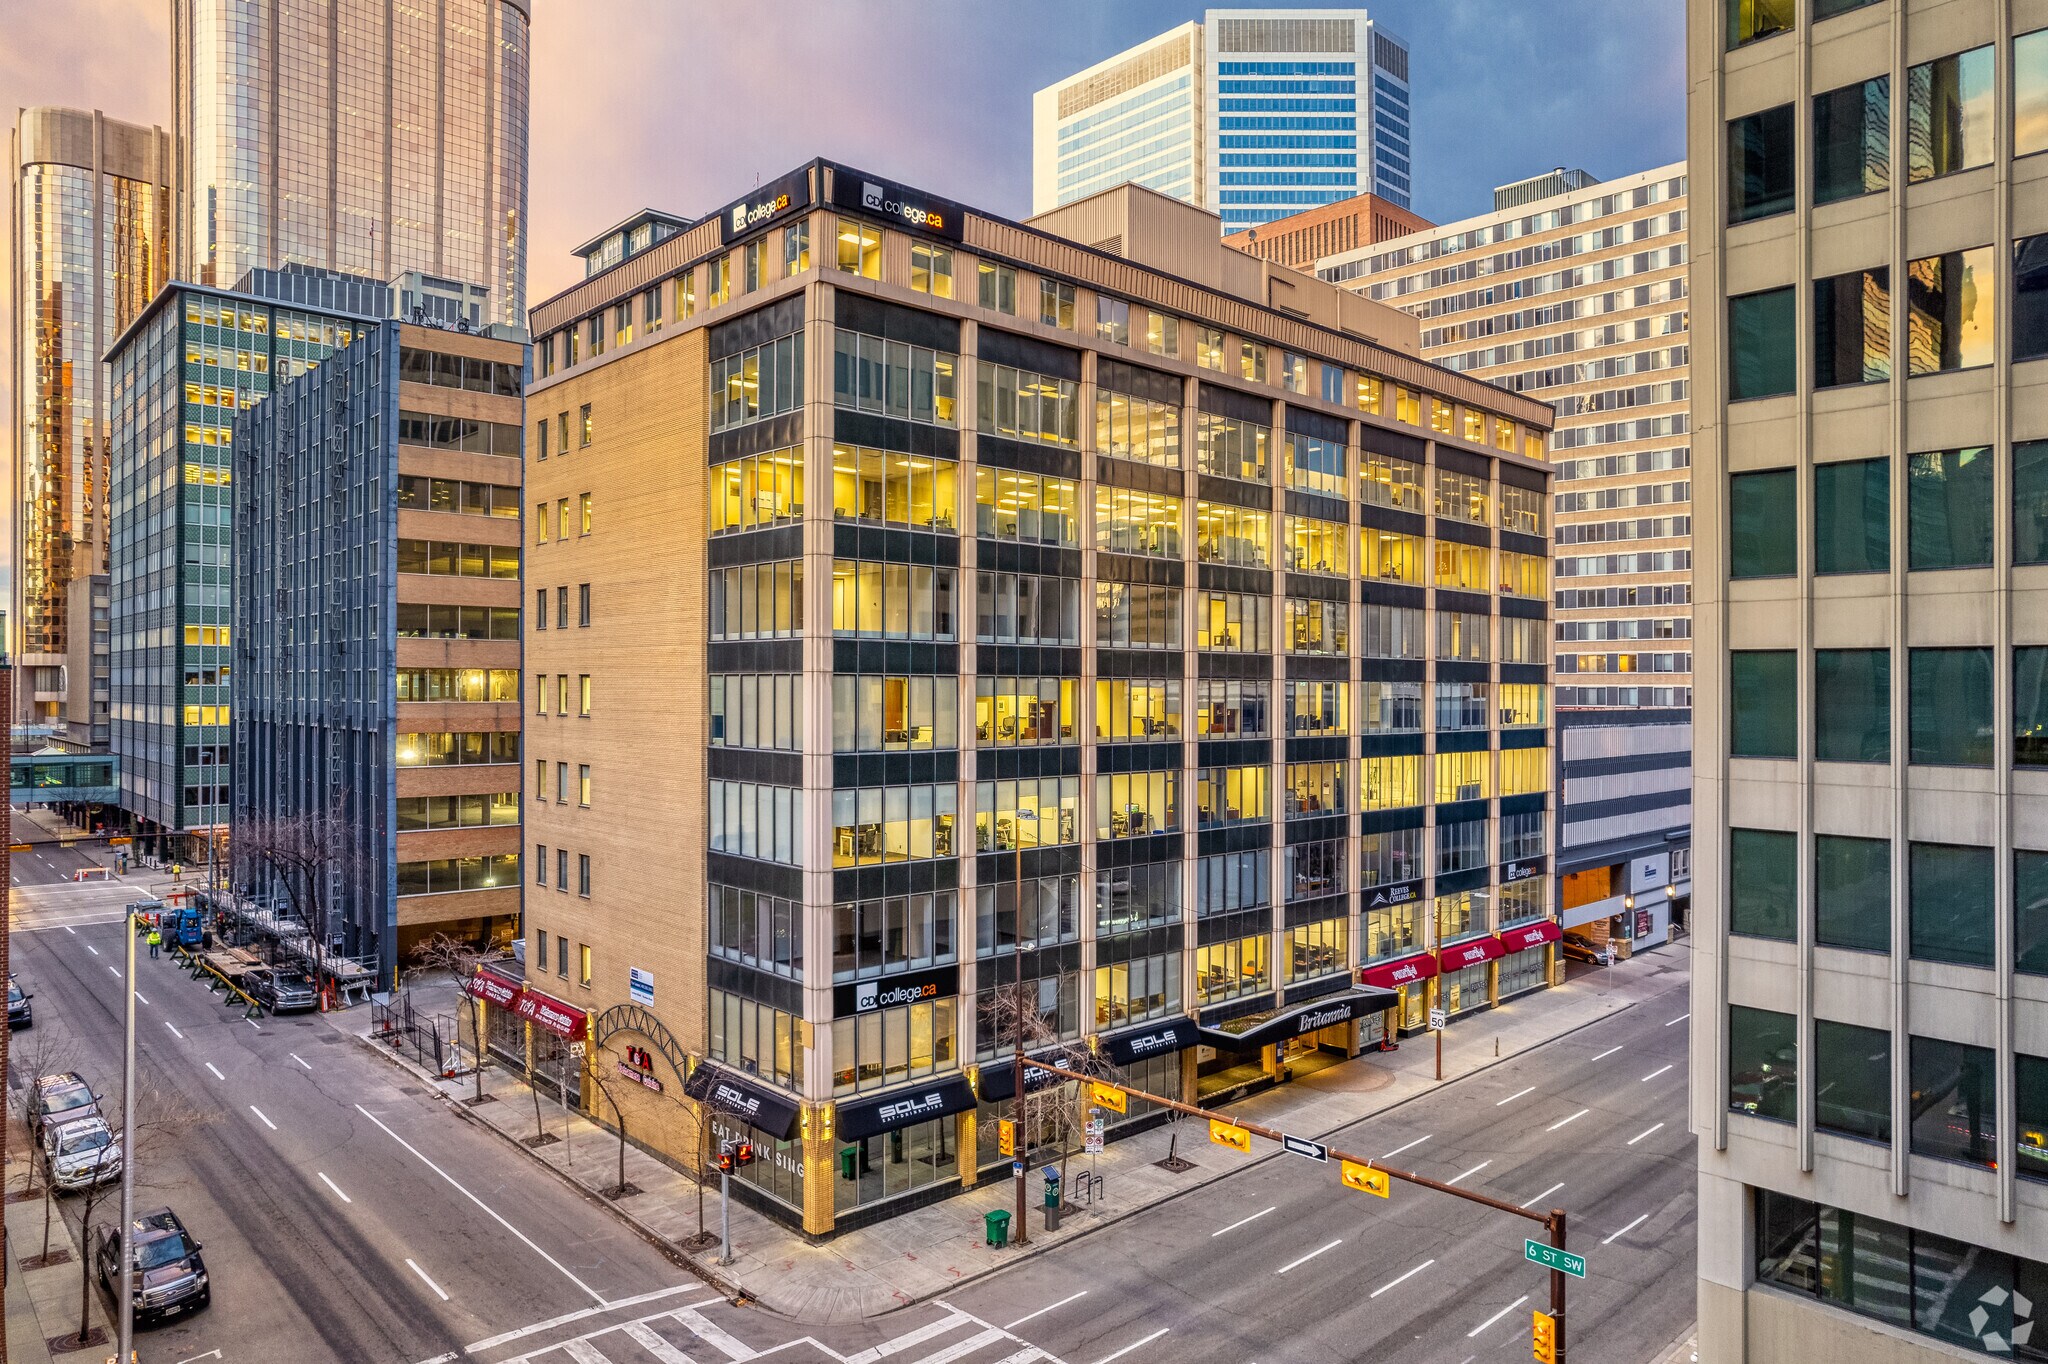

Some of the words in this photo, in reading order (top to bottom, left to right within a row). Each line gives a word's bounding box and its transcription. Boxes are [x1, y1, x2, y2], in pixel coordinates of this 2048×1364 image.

[747, 193, 789, 224] college.ca
[885, 200, 943, 229] college.ca
[880, 983, 937, 1004] college.ca
[1299, 1003, 1352, 1032] Britannia
[1431, 1017, 1444, 1028] 50
[1131, 1030, 1177, 1050] SOLE
[716, 1084, 761, 1111] SOLE
[879, 1092, 943, 1119] SOLE
[712, 1120, 731, 1140] EAT
[775, 1151, 805, 1178] SING
[1529, 1245, 1537, 1257] 6
[1542, 1250, 1557, 1263] ST
[1563, 1257, 1582, 1272] SW
